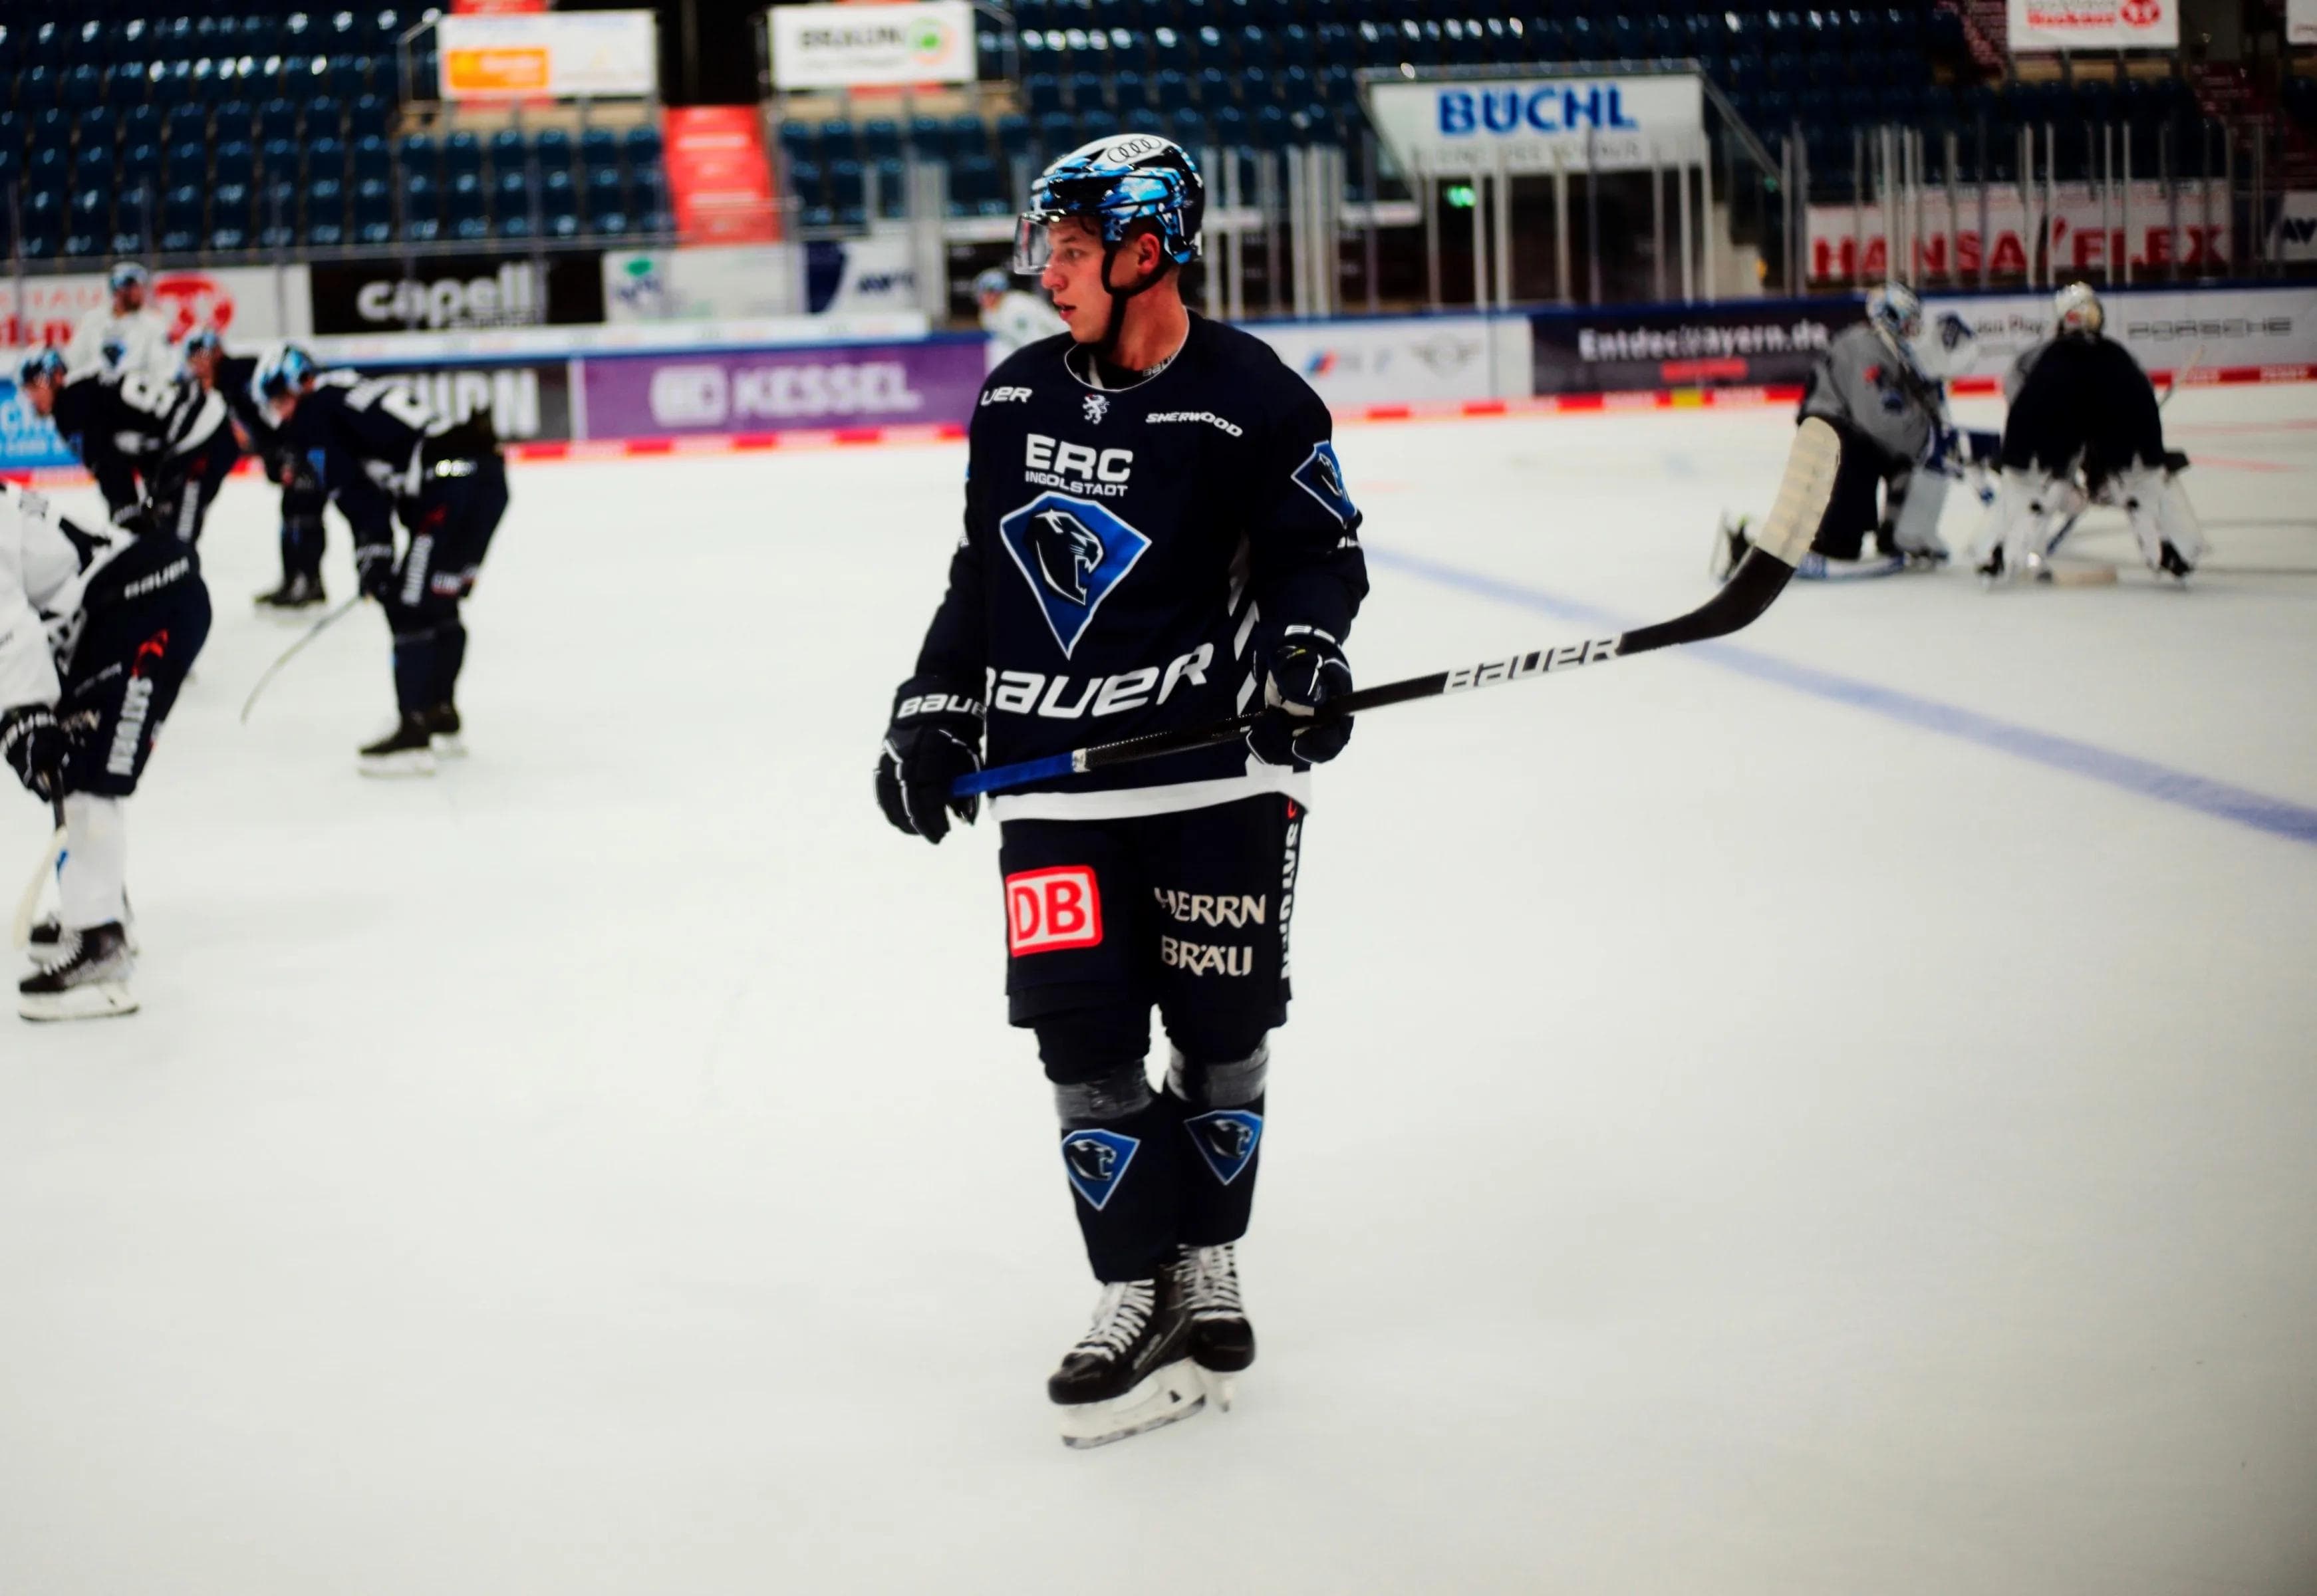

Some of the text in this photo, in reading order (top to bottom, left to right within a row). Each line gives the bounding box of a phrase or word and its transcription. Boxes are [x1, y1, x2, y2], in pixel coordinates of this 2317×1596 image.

[732, 360, 923, 419] KESSEL
[1145, 410, 1244, 438] SHERWOOD
[1026, 433, 1133, 482] ERC
[1025, 470, 1129, 497] INGOLSTADT
[1442, 632, 1623, 694] BAUER
[1012, 878, 1091, 942] DB
[1154, 887, 1266, 928] HERRN
[1161, 934, 1252, 976] BRÄU
